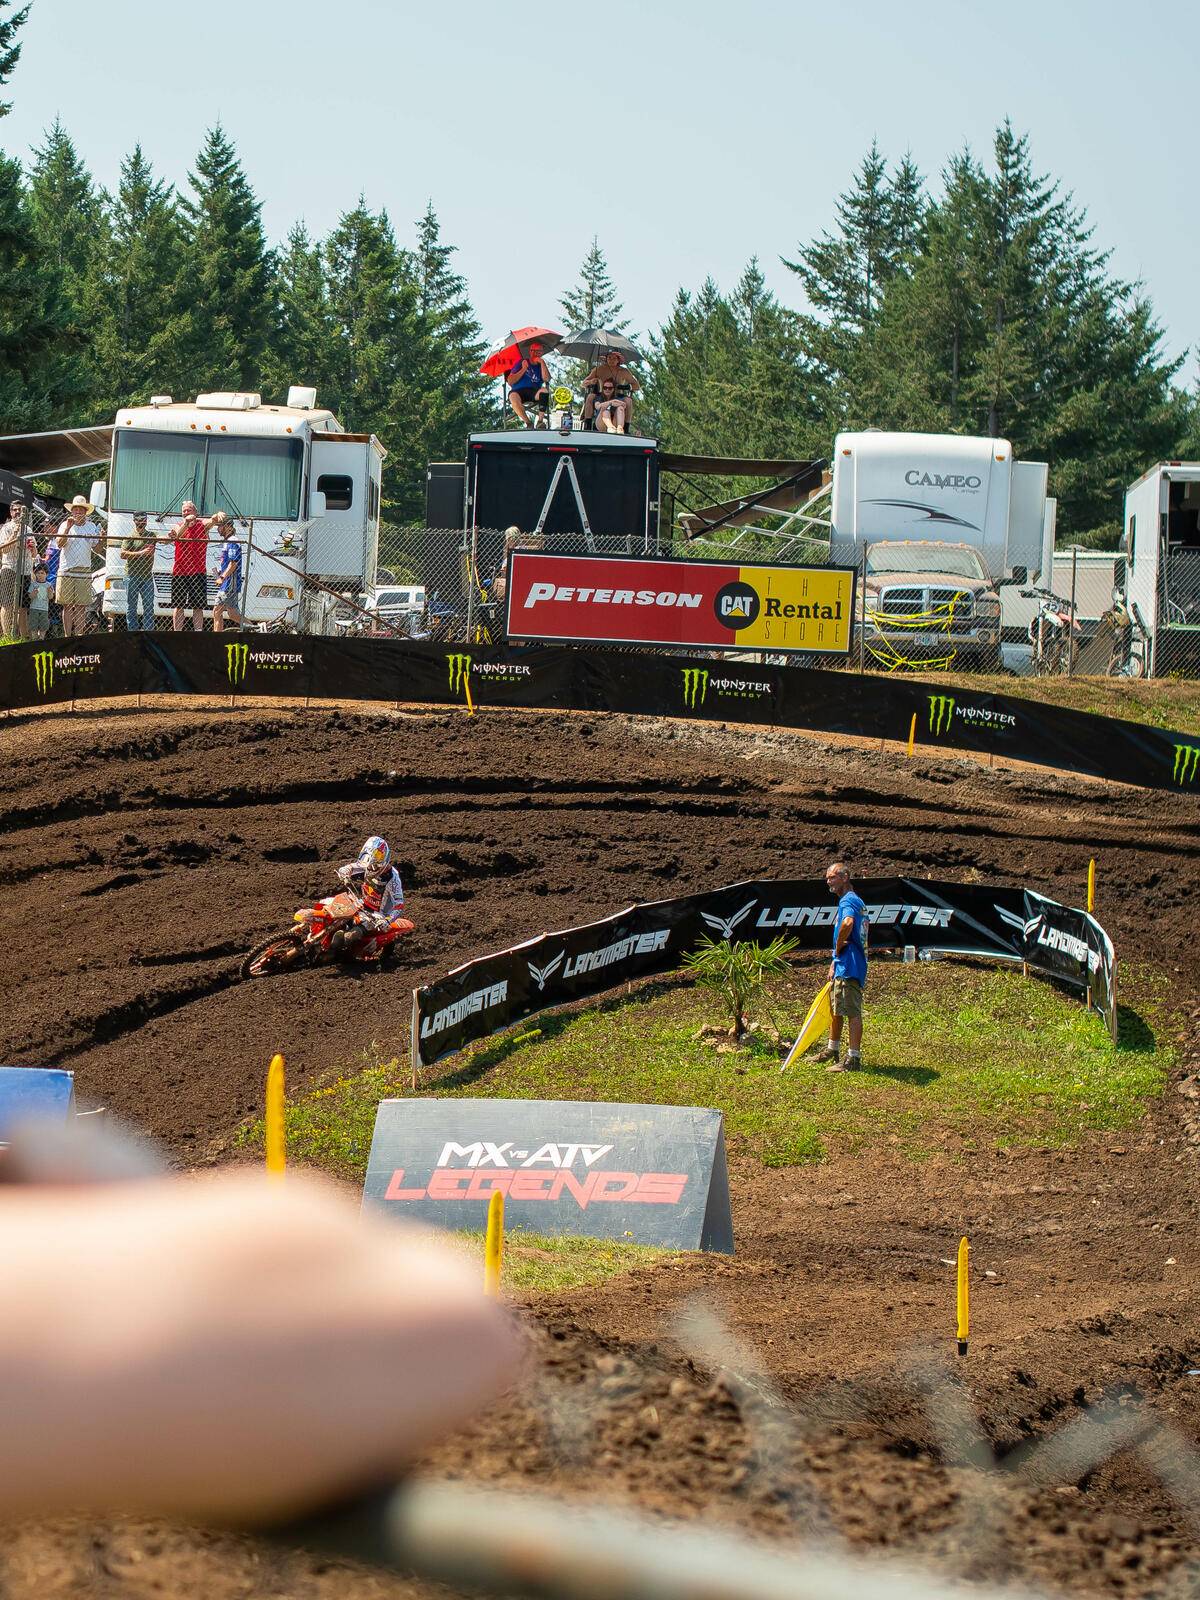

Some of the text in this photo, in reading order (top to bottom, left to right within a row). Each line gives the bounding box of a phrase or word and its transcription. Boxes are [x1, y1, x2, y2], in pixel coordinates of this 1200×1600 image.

[905, 470, 981, 489] CAMEO
[523, 582, 703, 609] PETERSON
[767, 576, 843, 599] THE
[720, 595, 753, 617] CAT
[764, 597, 842, 620] Rental
[765, 620, 840, 643] STORE
[54, 654, 101, 669] MONSTER
[249, 651, 304, 664] MONSTER
[472, 662, 531, 675] MONSTER
[710, 678, 771, 693] MONSTER
[955, 706, 1016, 726] MONSTER
[756, 904, 954, 928] LANDASTER
[562, 929, 671, 979] LANDMASTER
[420, 980, 508, 1039] LANDMASTER
[436, 1141, 515, 1167] MX
[520, 1143, 615, 1168] ATV
[384, 1169, 689, 1210] LEGENDS
